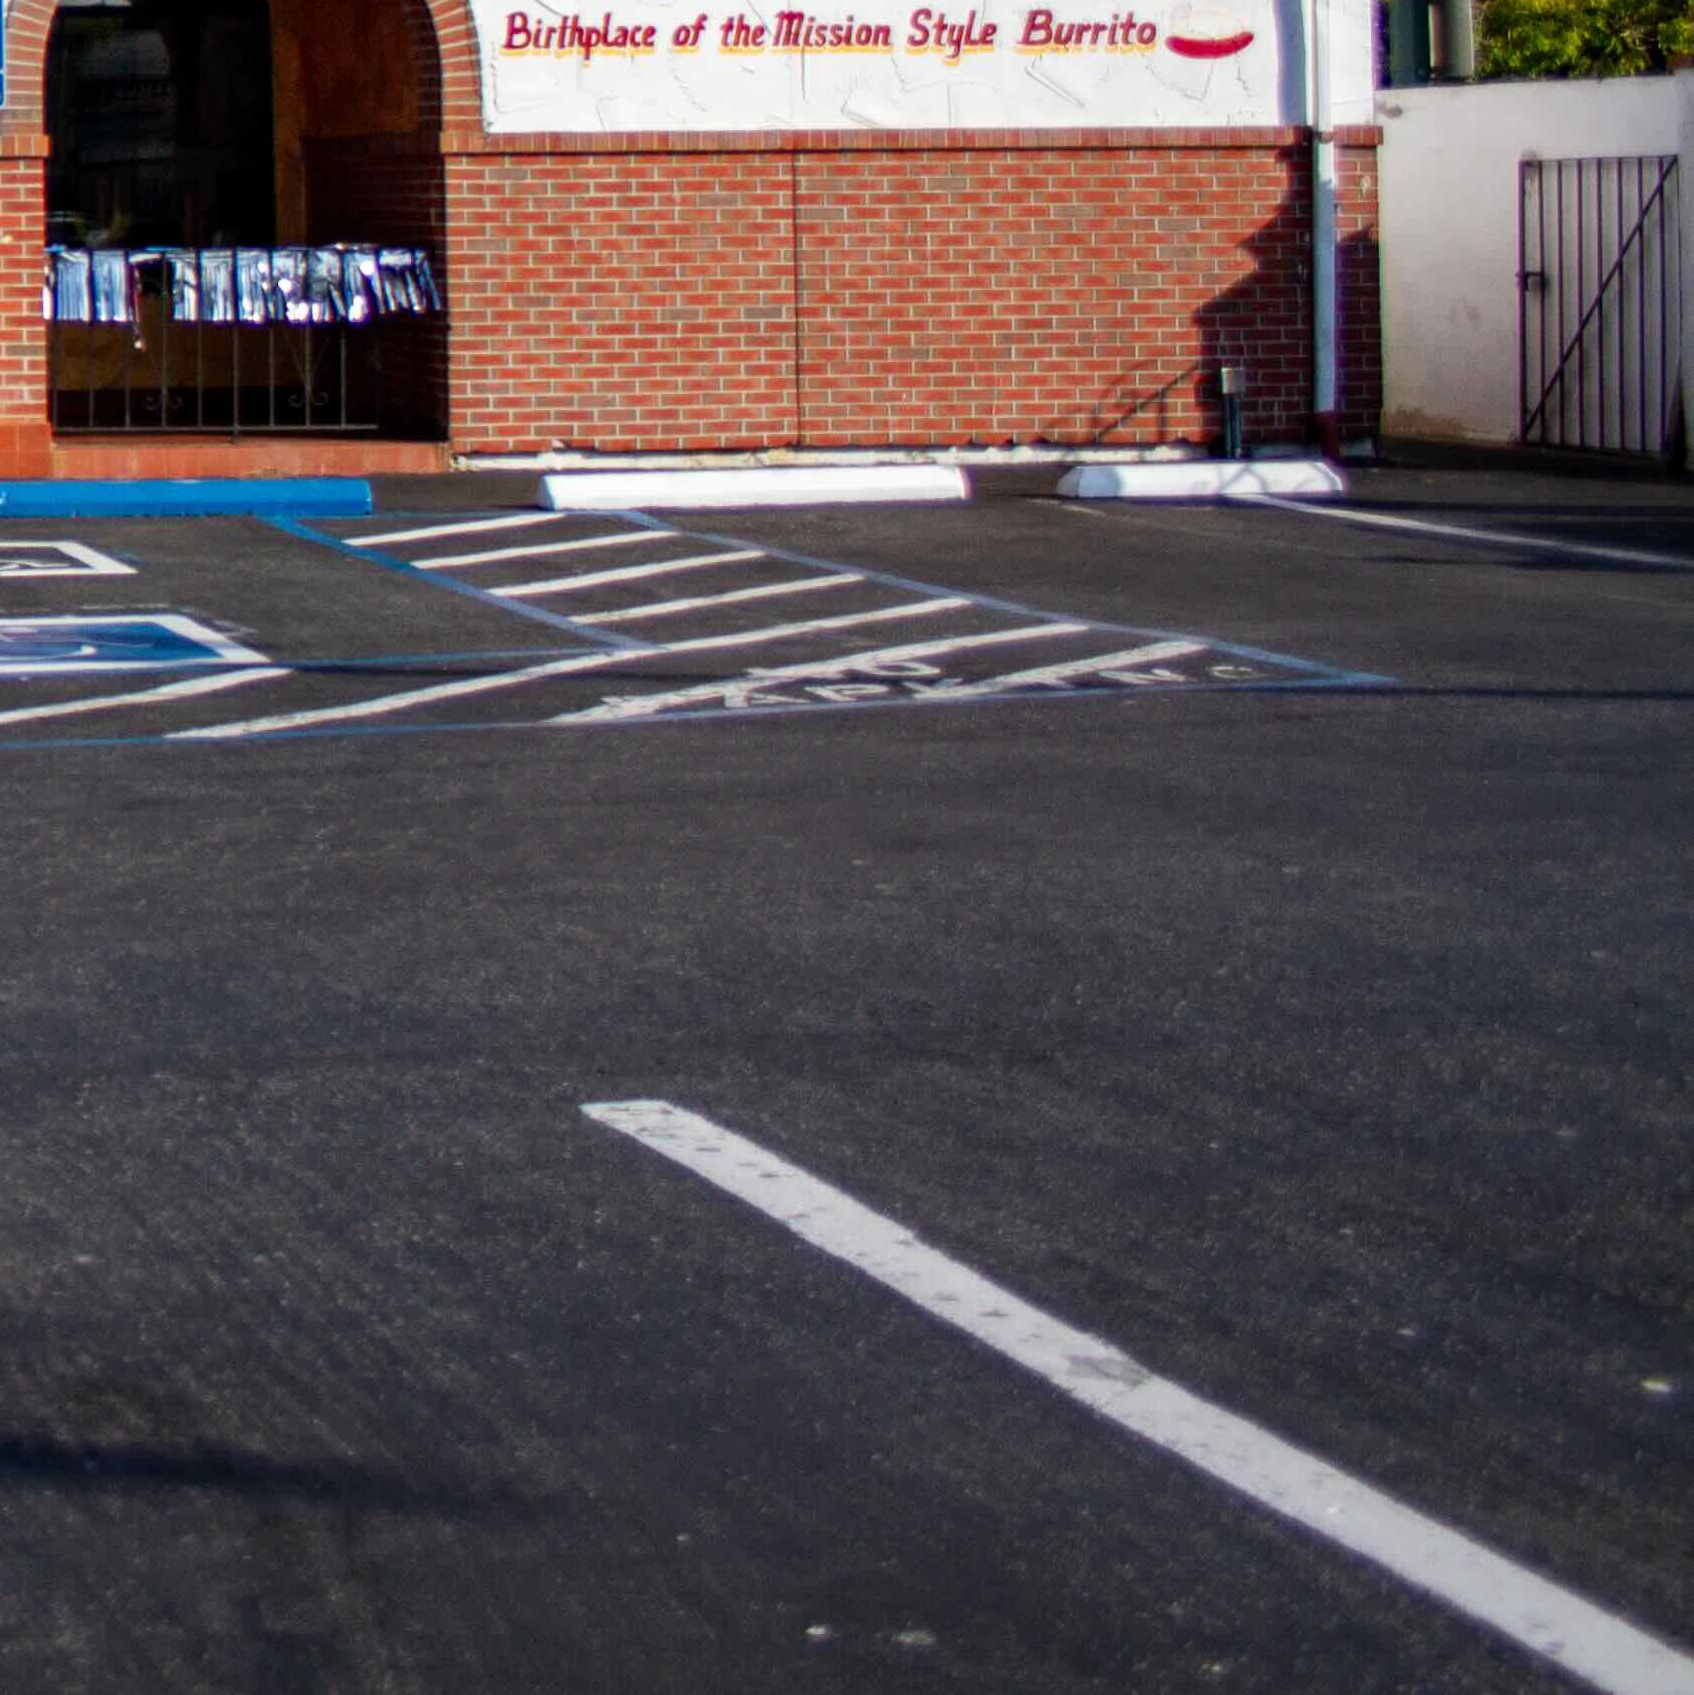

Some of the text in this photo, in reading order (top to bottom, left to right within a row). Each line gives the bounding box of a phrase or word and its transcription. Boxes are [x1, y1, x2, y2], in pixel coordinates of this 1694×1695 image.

[503, 8, 1157, 61] Birthplace of the Mission Style Burrito
